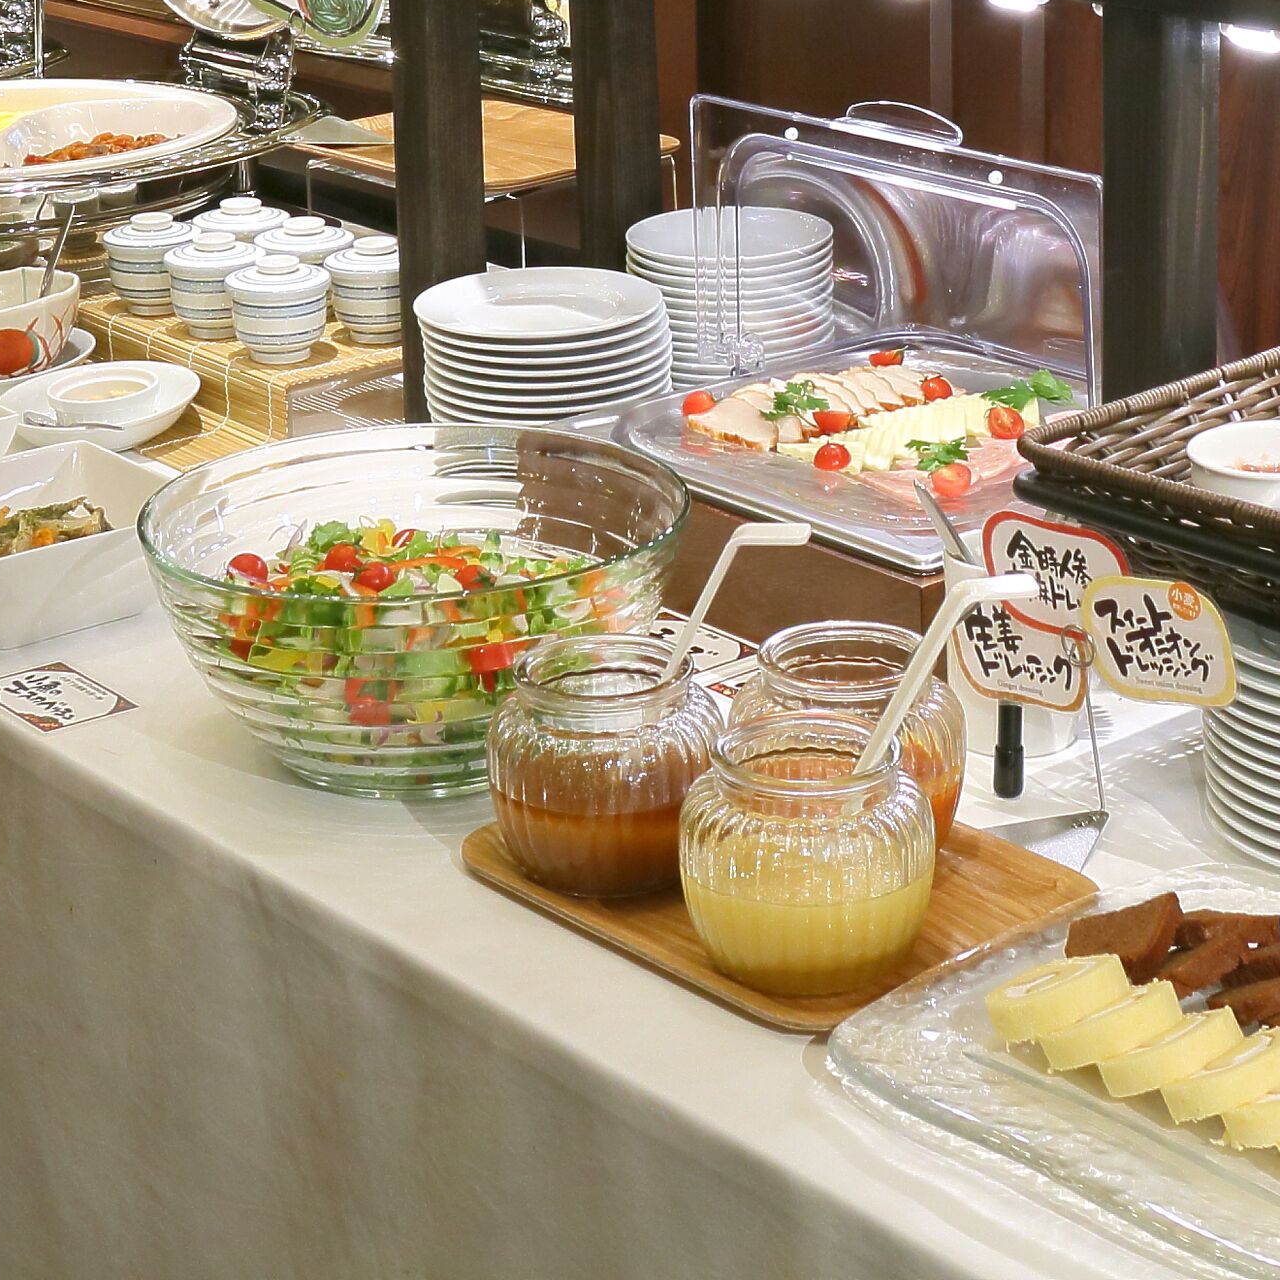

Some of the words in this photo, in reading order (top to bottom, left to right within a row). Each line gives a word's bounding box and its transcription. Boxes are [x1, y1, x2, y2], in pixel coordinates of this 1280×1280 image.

[1007, 530, 1093, 588] 金時人参
[964, 602, 1023, 654] 生姜
[1094, 594, 1173, 634] スイート
[1106, 637, 1214, 682] ドレッシング
[1126, 627, 1200, 659] オニオン
[25, 674, 63, 696] 小魚の
[975, 643, 1077, 691] ドレッシング
